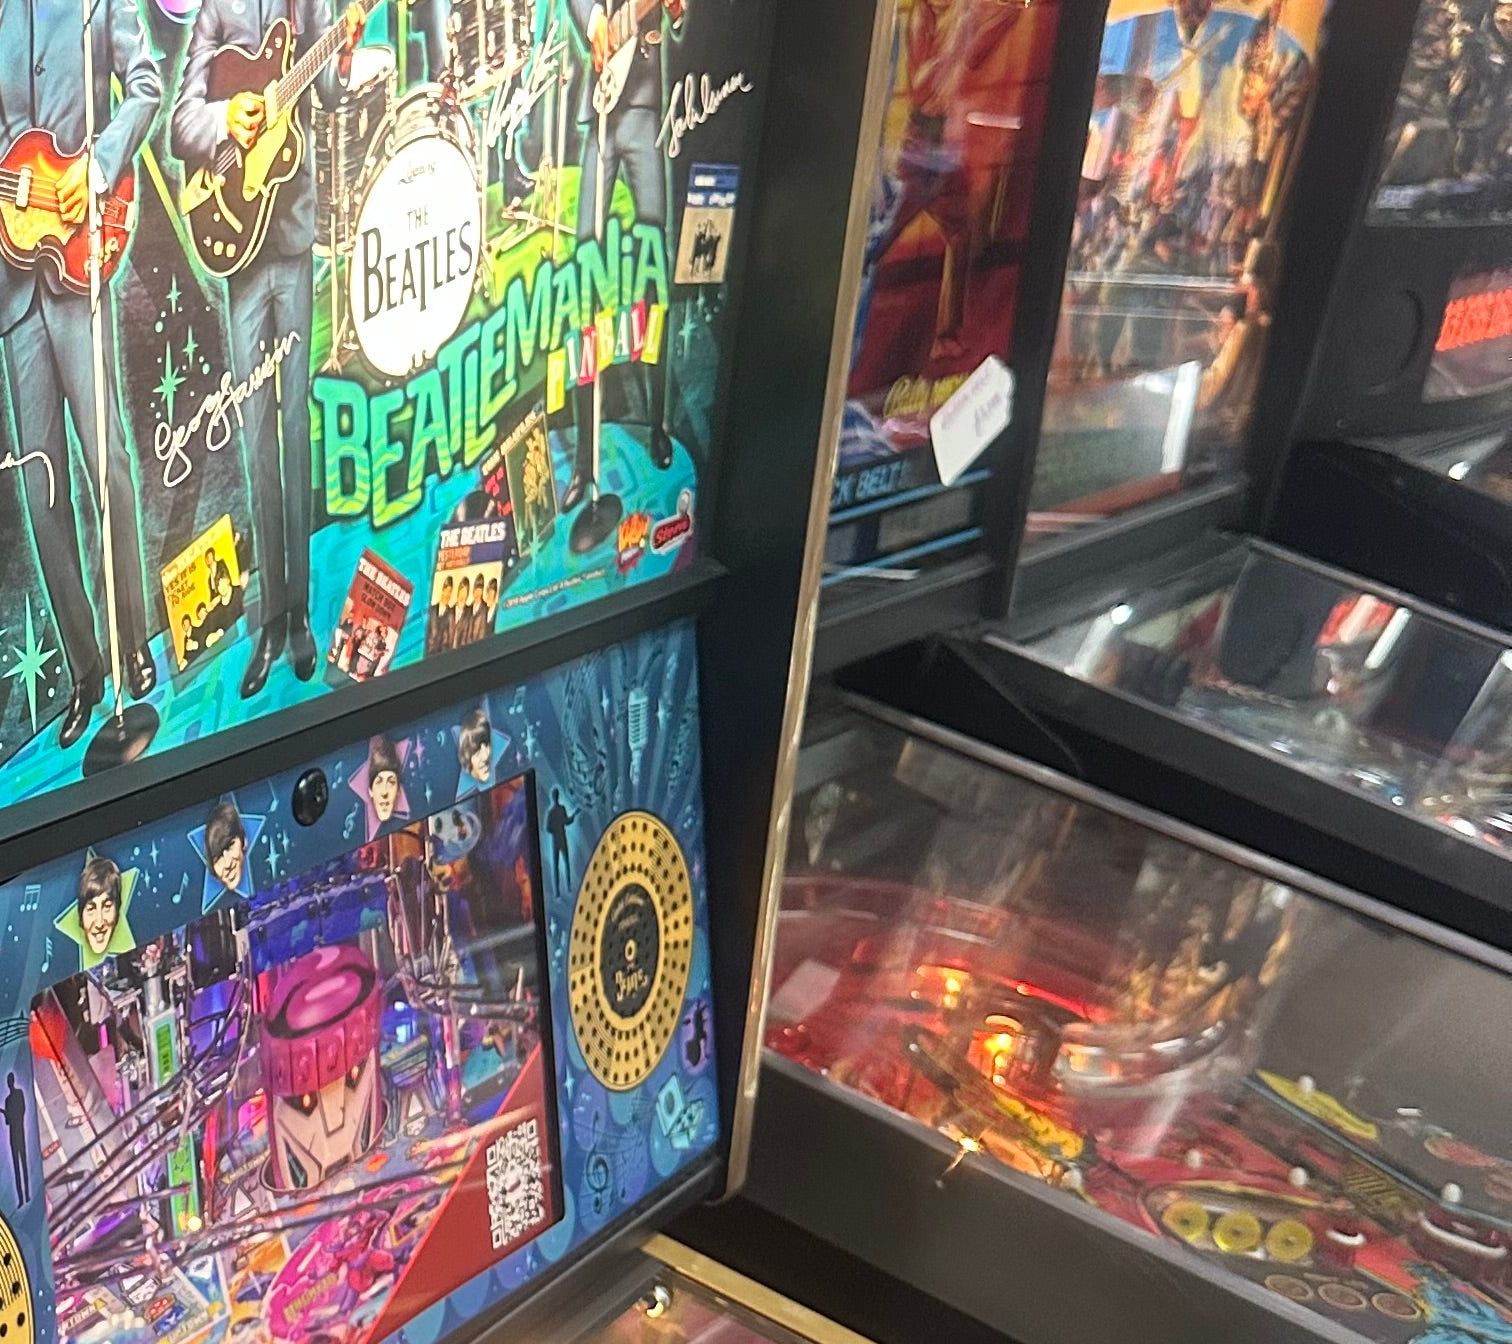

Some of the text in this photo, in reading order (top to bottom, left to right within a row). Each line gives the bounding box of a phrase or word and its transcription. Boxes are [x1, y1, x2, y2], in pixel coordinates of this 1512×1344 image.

[407, 205, 429, 231] THE
[361, 220, 473, 323] BEATLES
[546, 300, 665, 414] PINBALL
[441, 522, 506, 549] THE BEATLES
